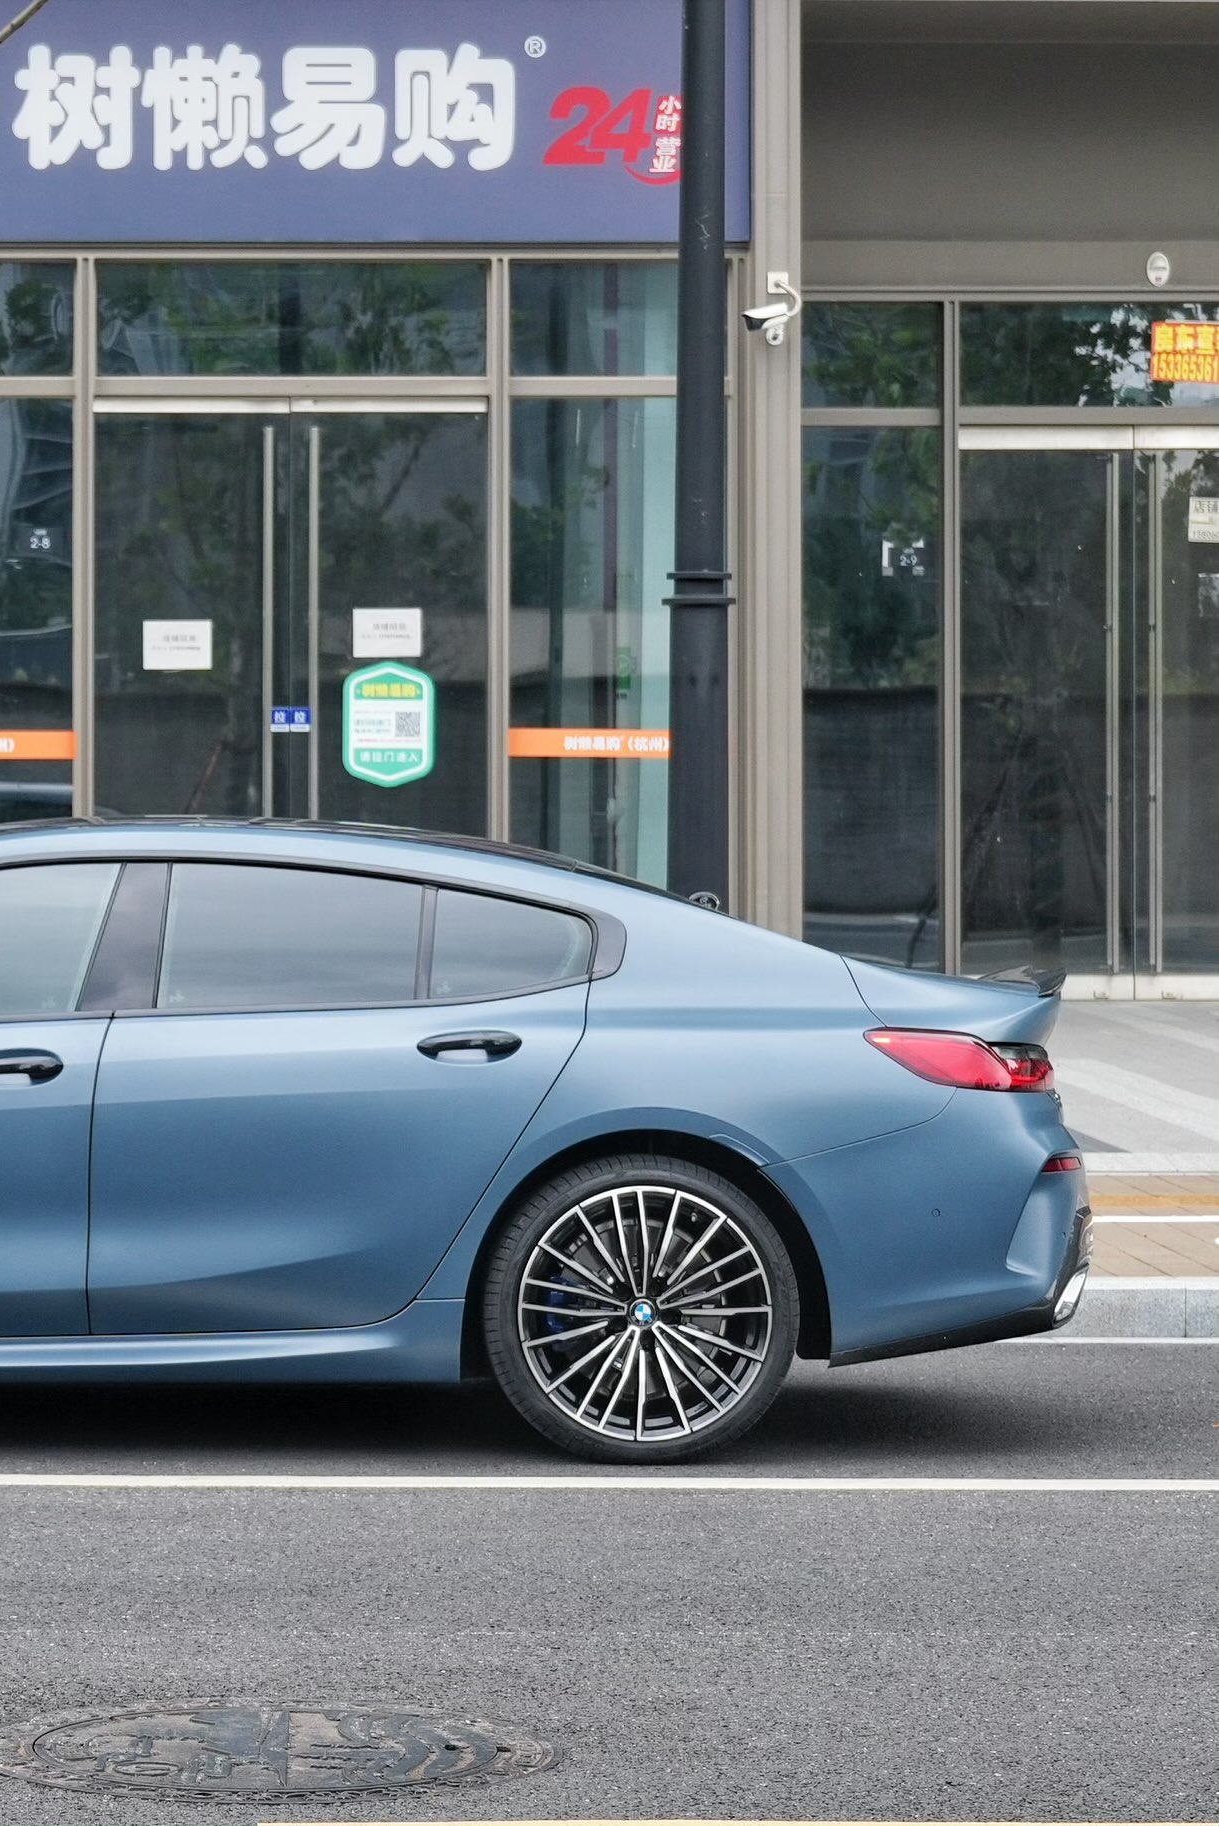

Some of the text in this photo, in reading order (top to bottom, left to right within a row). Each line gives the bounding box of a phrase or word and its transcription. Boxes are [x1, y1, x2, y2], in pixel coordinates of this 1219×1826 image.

[12, 43, 516, 171] 树懒易购
[543, 85, 653, 166] 24
[1155, 325, 1219, 355] 房东直
[30, 536, 51, 549] 2-8
[274, 710, 286, 723] 拉
[294, 710, 306, 723] 拉
